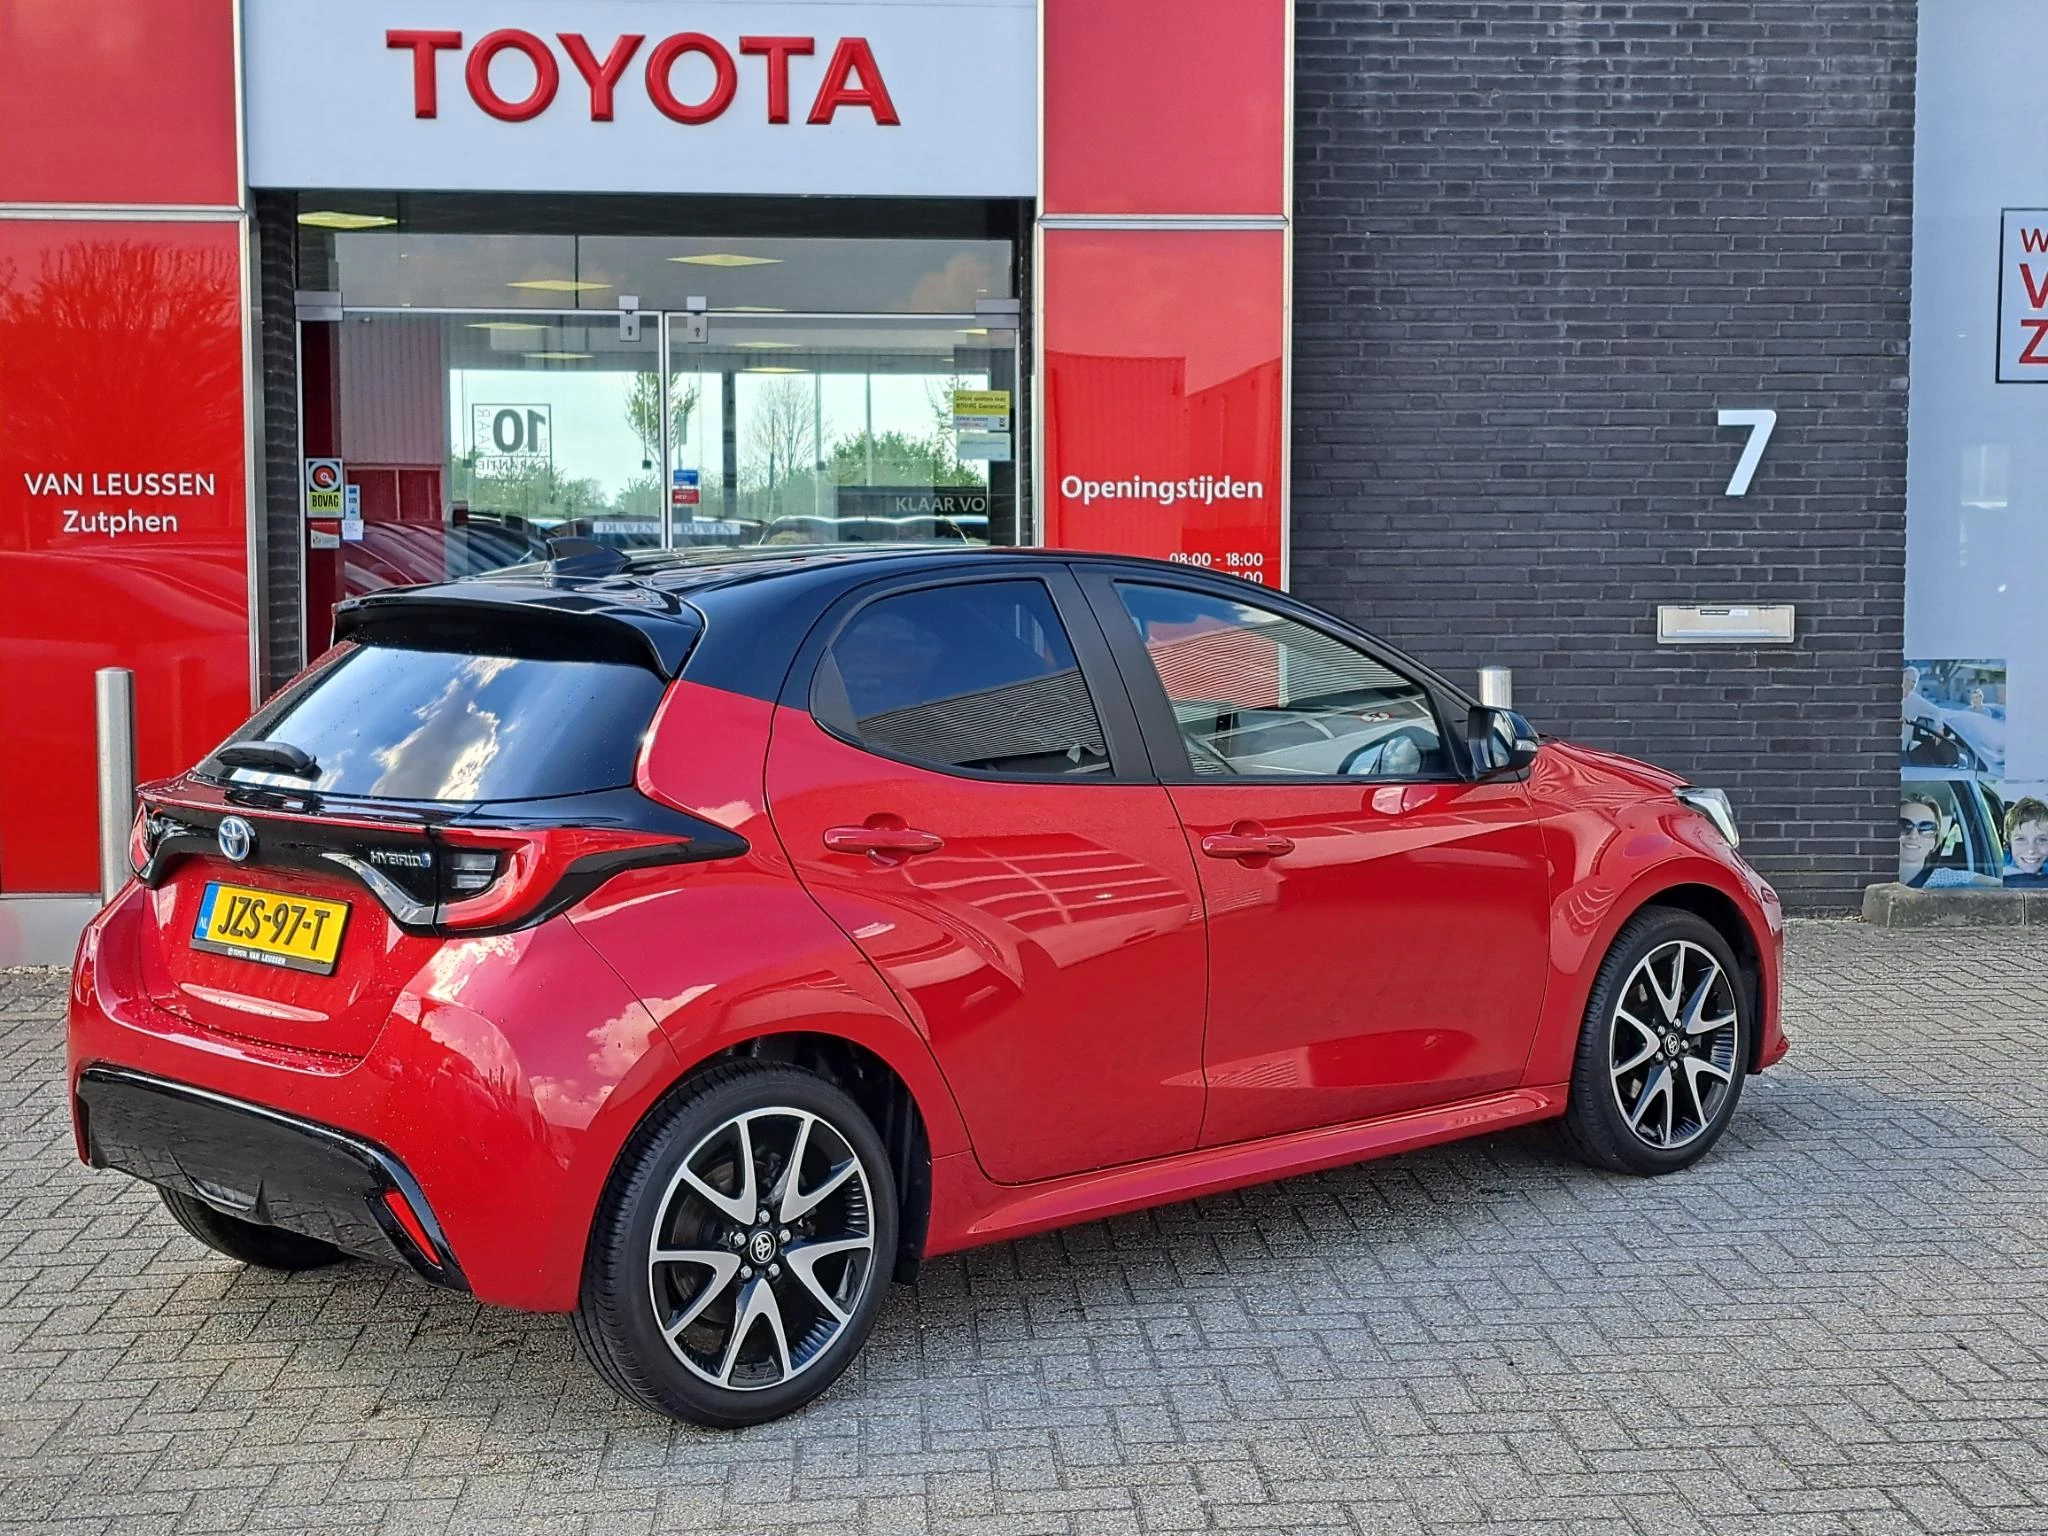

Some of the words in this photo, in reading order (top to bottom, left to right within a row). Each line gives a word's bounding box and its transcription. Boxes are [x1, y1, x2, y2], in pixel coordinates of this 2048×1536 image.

[386, 28, 901, 126] TOYOTA
[2018, 319, 2048, 364] Z
[1717, 409, 1777, 496] 7
[24, 473, 83, 496] VAN
[92, 473, 215, 496] LEUSSEN
[1061, 475, 1263, 505] Openingstijden
[312, 494, 339, 508] BOVAG
[895, 496, 955, 512] KLAAR
[958, 496, 986, 512] VO
[63, 509, 178, 538] Zutphen
[602, 522, 655, 533] DUWEN
[1169, 552, 1212, 566] 08:00
[1226, 552, 1263, 566] 18:00
[370, 850, 422, 867] HYBRID
[198, 917, 208, 930] NL
[217, 895, 331, 951] JZS-97-T
[248, 950, 261, 961] VAN
